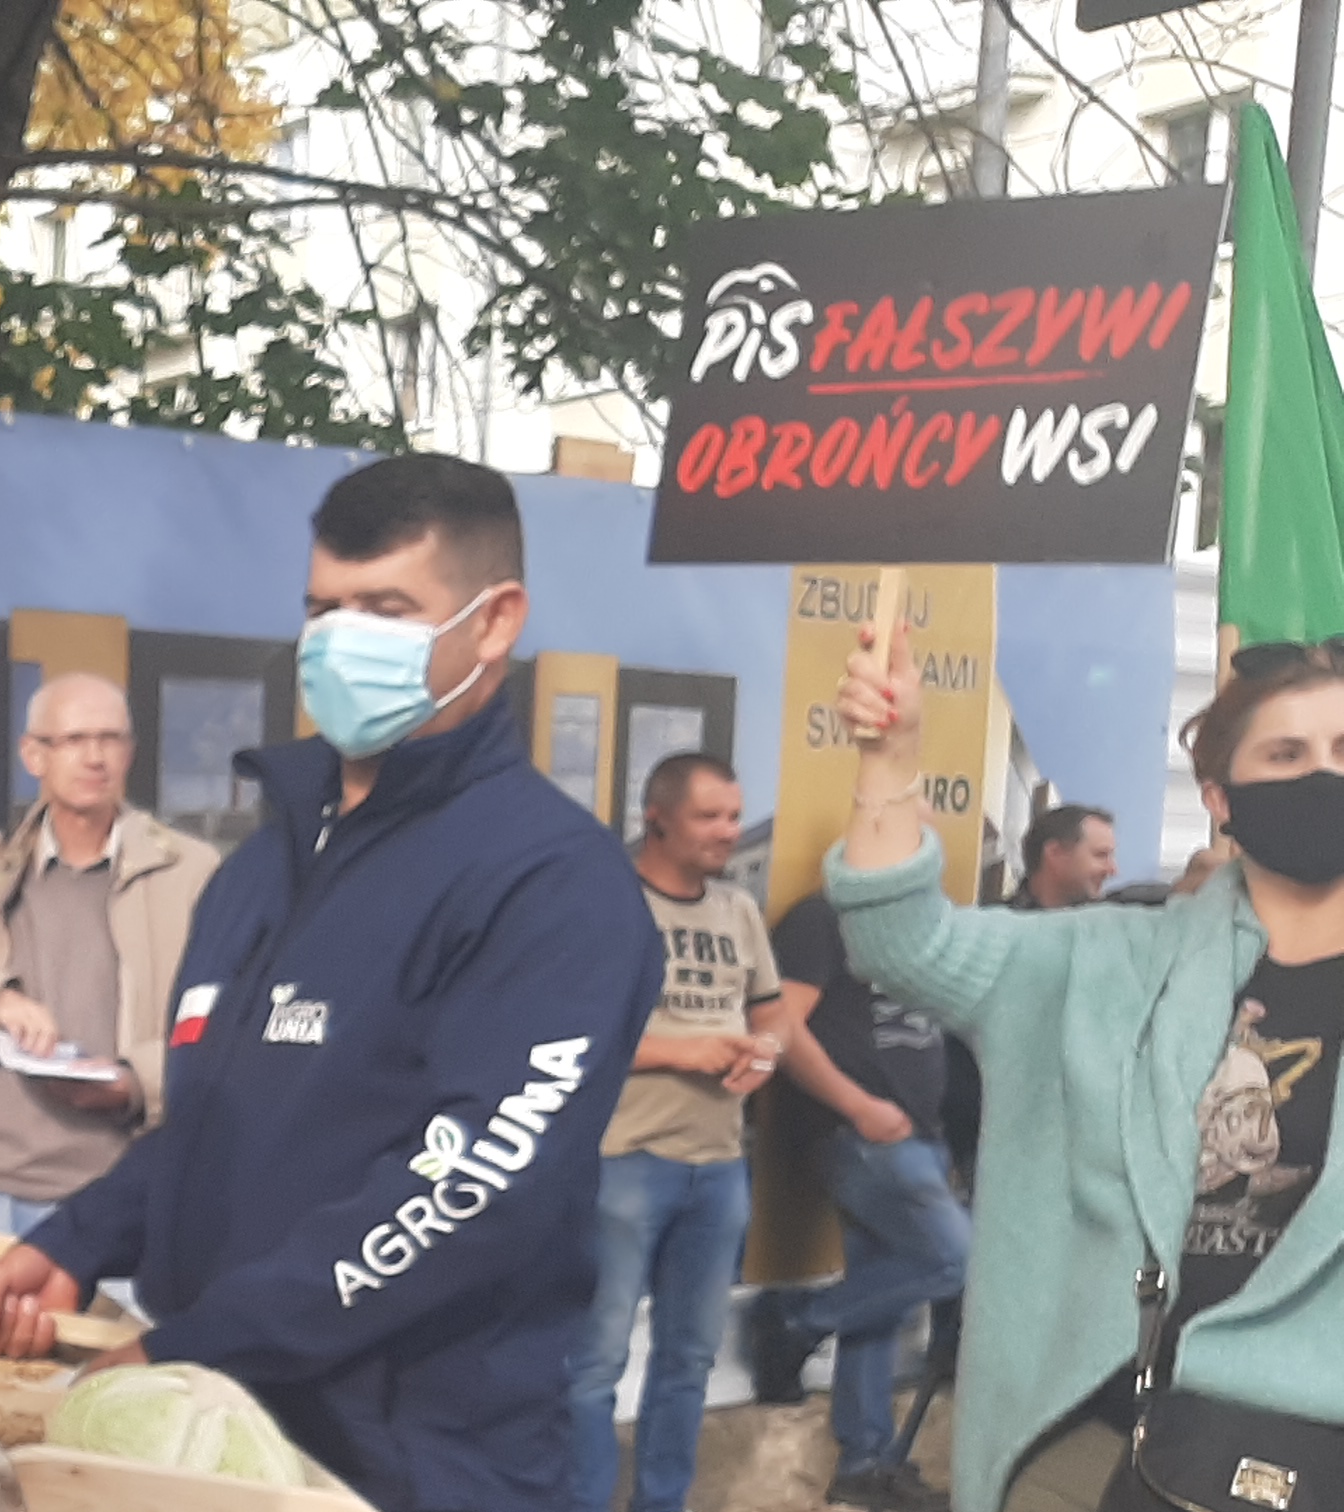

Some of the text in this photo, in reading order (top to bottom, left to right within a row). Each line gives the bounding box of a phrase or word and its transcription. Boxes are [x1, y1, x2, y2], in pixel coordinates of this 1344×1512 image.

[810, 281, 1191, 373] FAŁSZYWI
[676, 396, 1158, 498] OBROŃCY WSI
